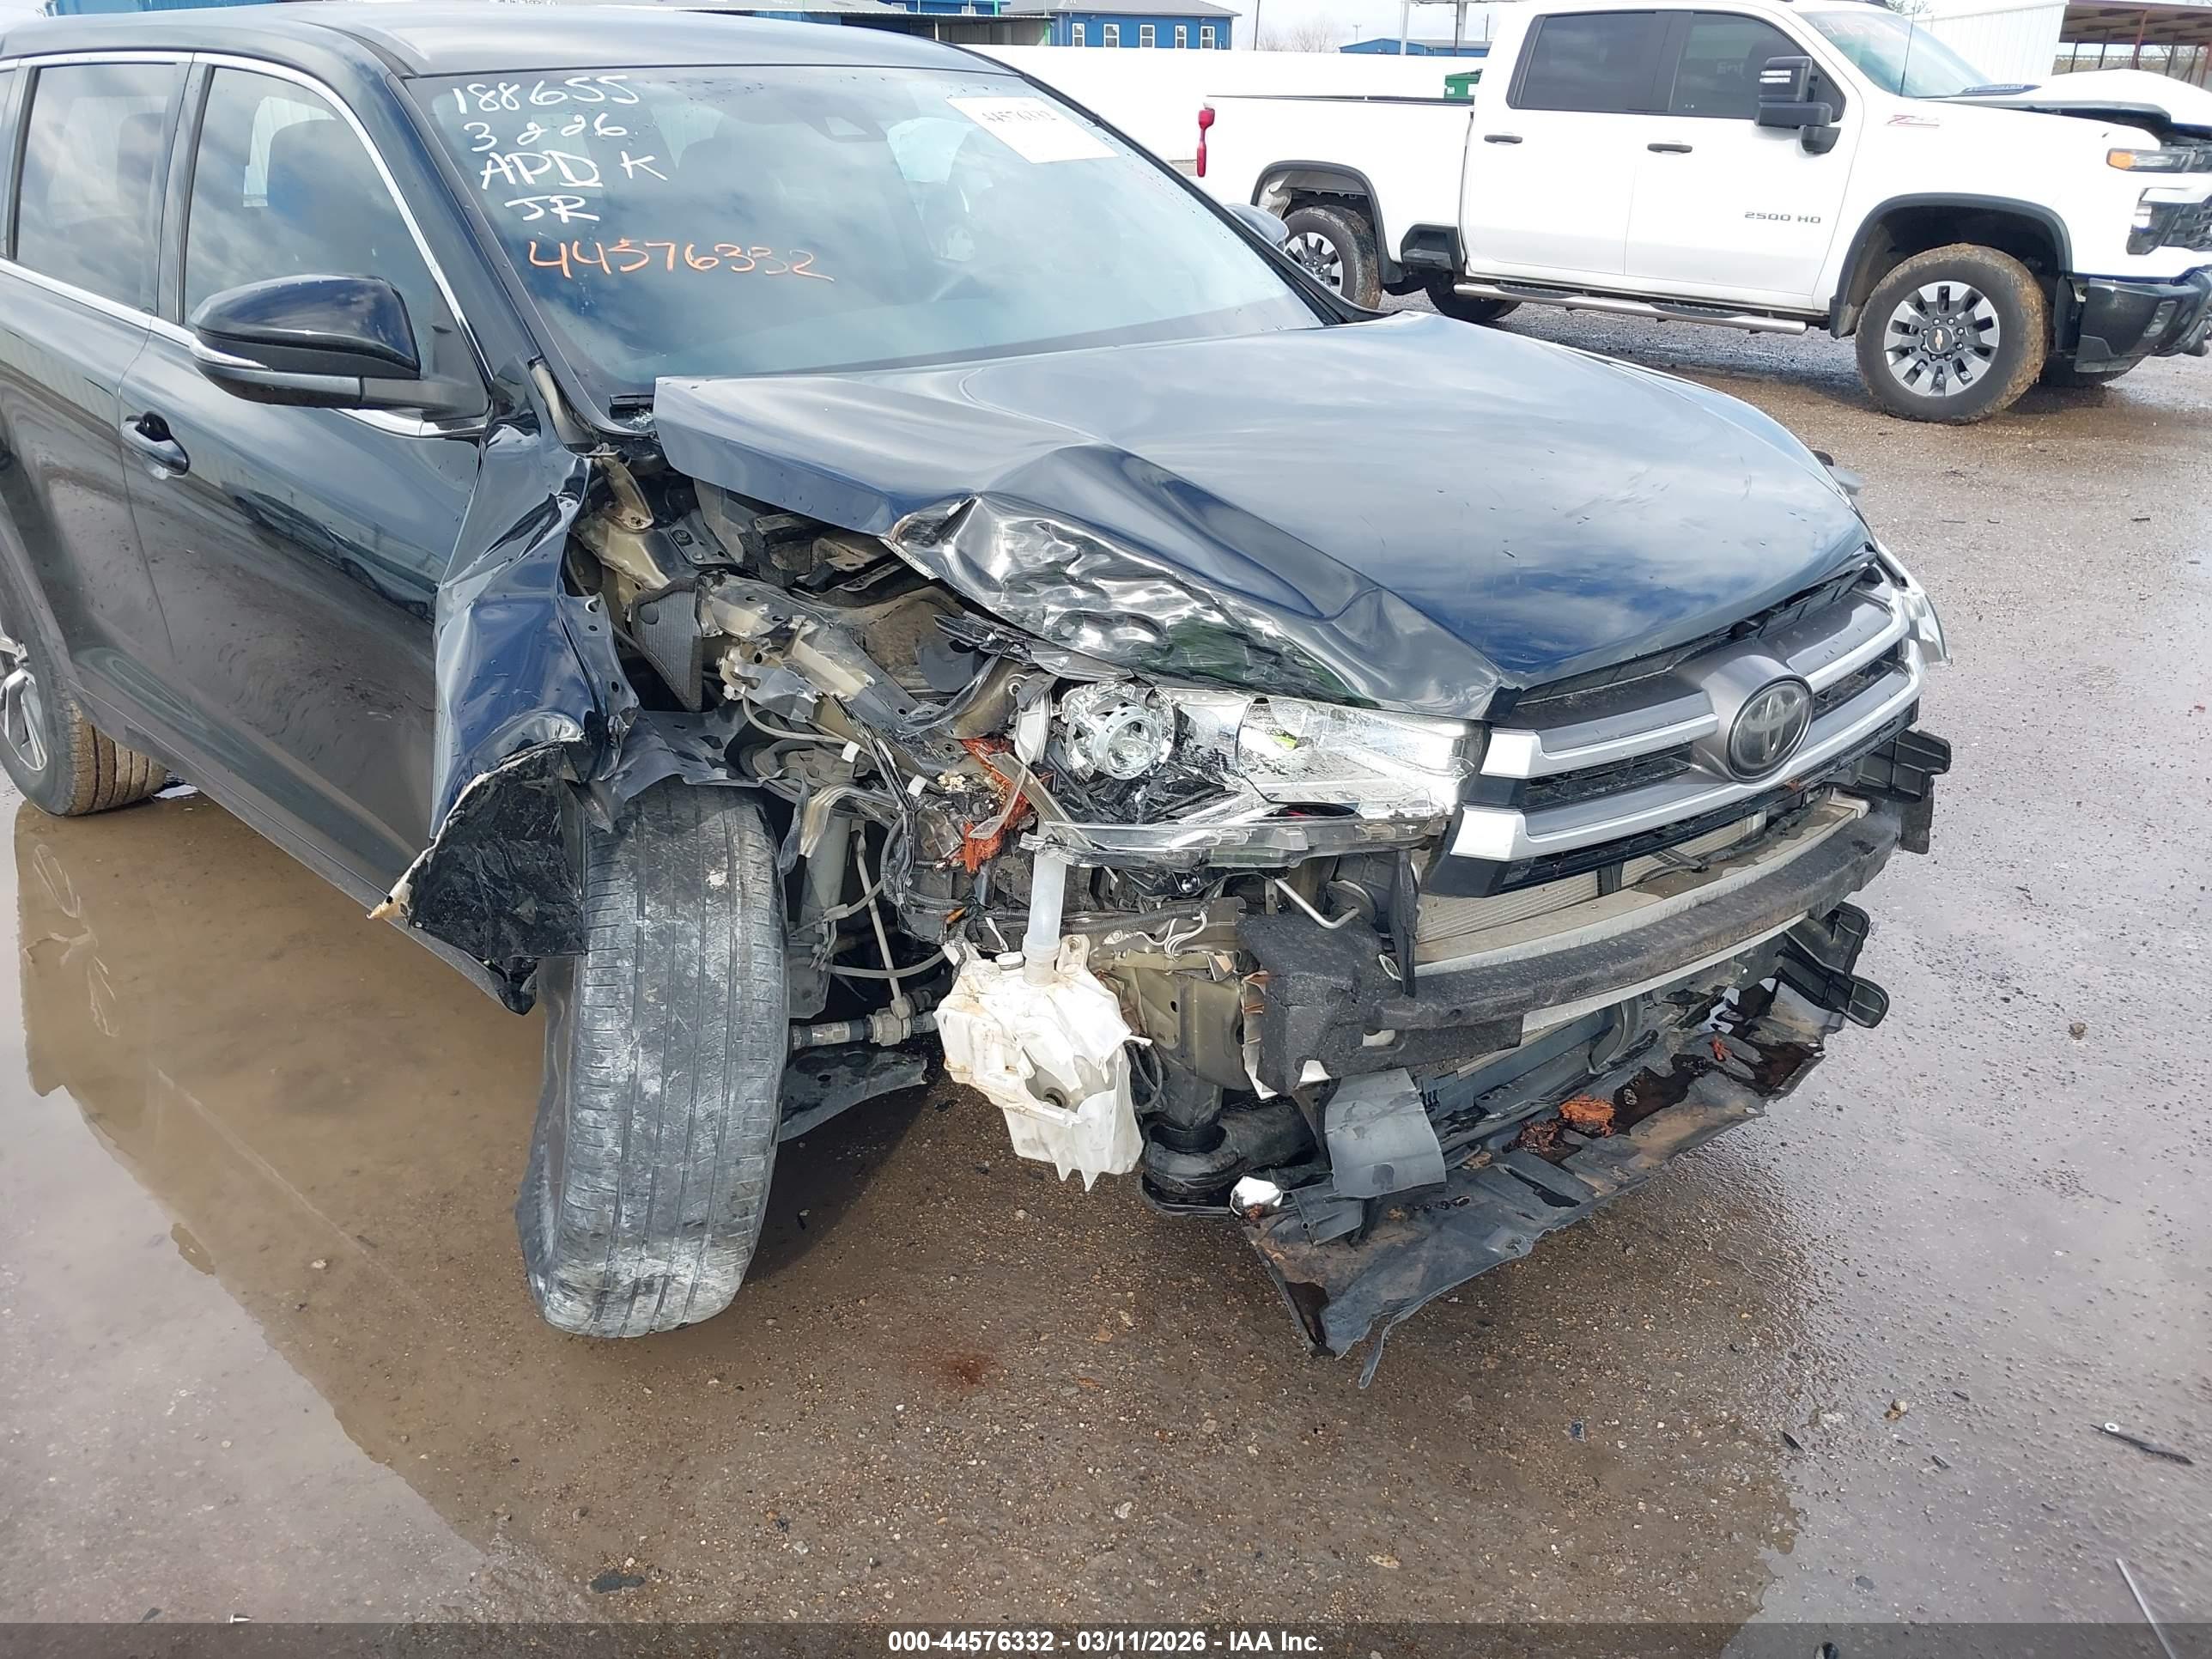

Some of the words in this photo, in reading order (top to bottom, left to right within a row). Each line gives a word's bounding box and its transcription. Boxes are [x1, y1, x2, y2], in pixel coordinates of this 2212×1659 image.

[452, 75, 640, 115] 188655
[619, 150, 668, 181] K
[1744, 211, 1791, 222] 2500
